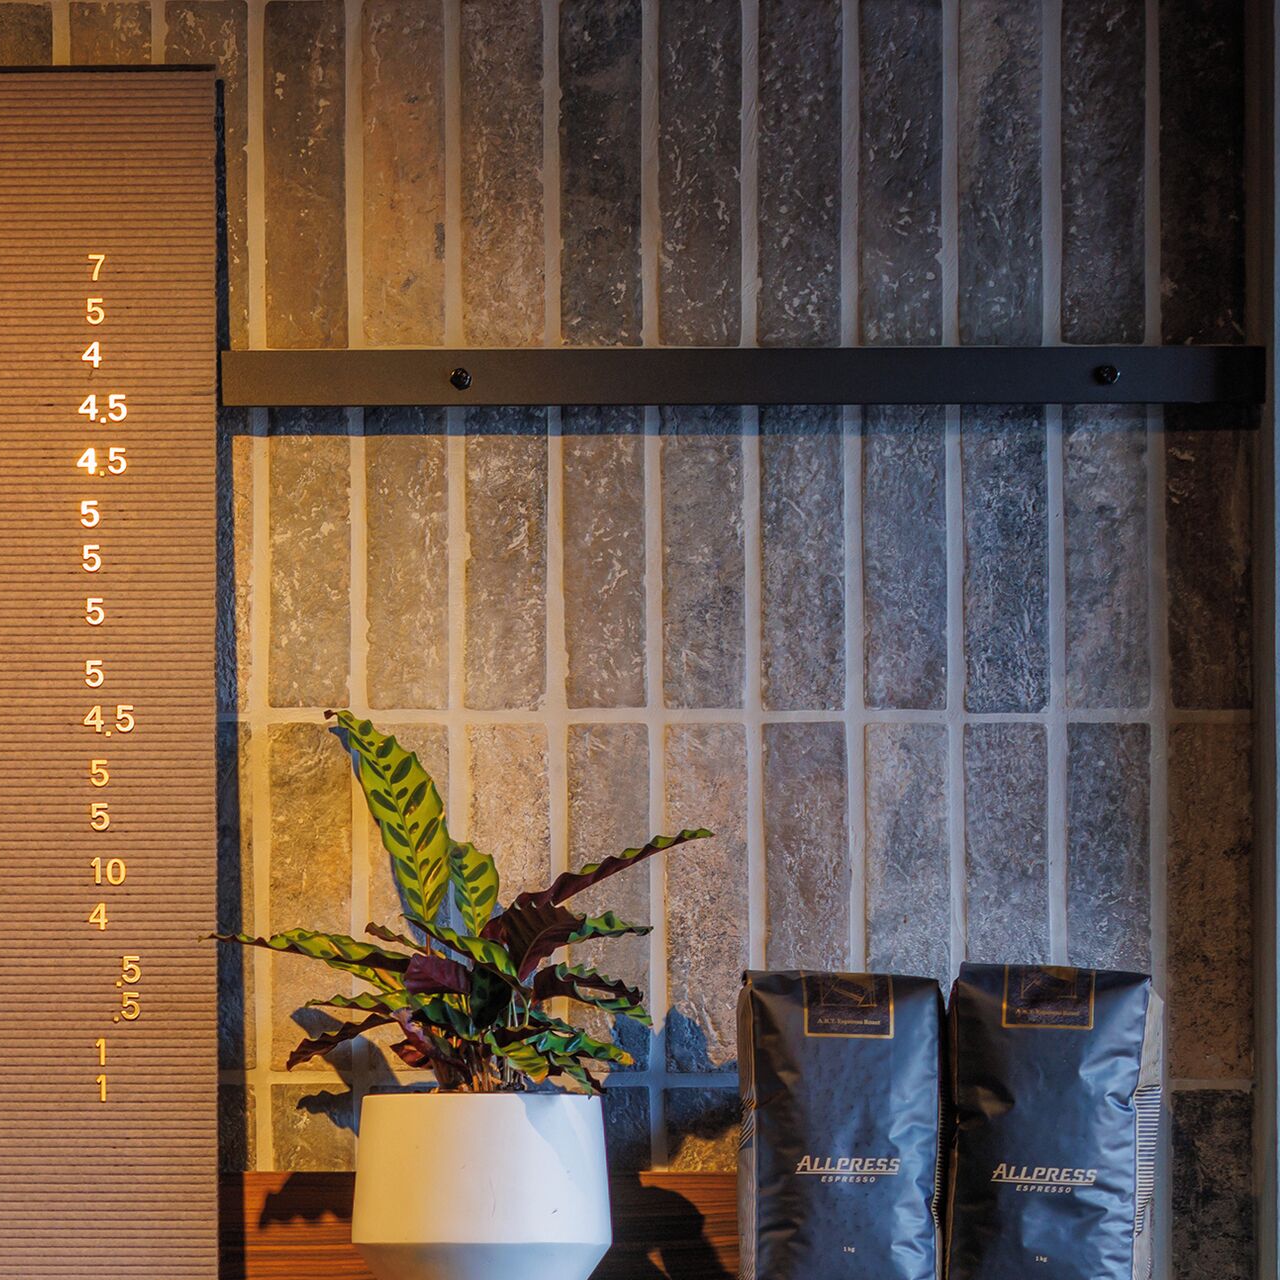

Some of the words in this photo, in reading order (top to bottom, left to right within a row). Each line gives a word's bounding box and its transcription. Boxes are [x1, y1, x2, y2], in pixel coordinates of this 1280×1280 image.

[87, 253, 106, 281] 7
[86, 297, 105, 325] 5
[81, 341, 103, 368] 4
[77, 393, 128, 424] 4.5
[76, 446, 127, 477] 4.5
[80, 500, 100, 528] 5
[82, 544, 102, 572] 5
[85, 597, 105, 625] 5
[85, 659, 104, 687] 5
[83, 704, 135, 737] 4.5
[90, 759, 109, 787] 5
[90, 802, 110, 831] 5
[90, 856, 126, 885] 10
[88, 903, 109, 930] 4
[116, 955, 142, 987] .5
[114, 991, 140, 1022] .5
[95, 1038, 106, 1066] 1
[96, 1074, 107, 1102] 1
[795, 1155, 901, 1172] ALLPRESS
[991, 1163, 1097, 1181] ALLPRESS
[820, 1175, 877, 1183] ESPRESSO
[1016, 1184, 1072, 1194] ESPRESSO
